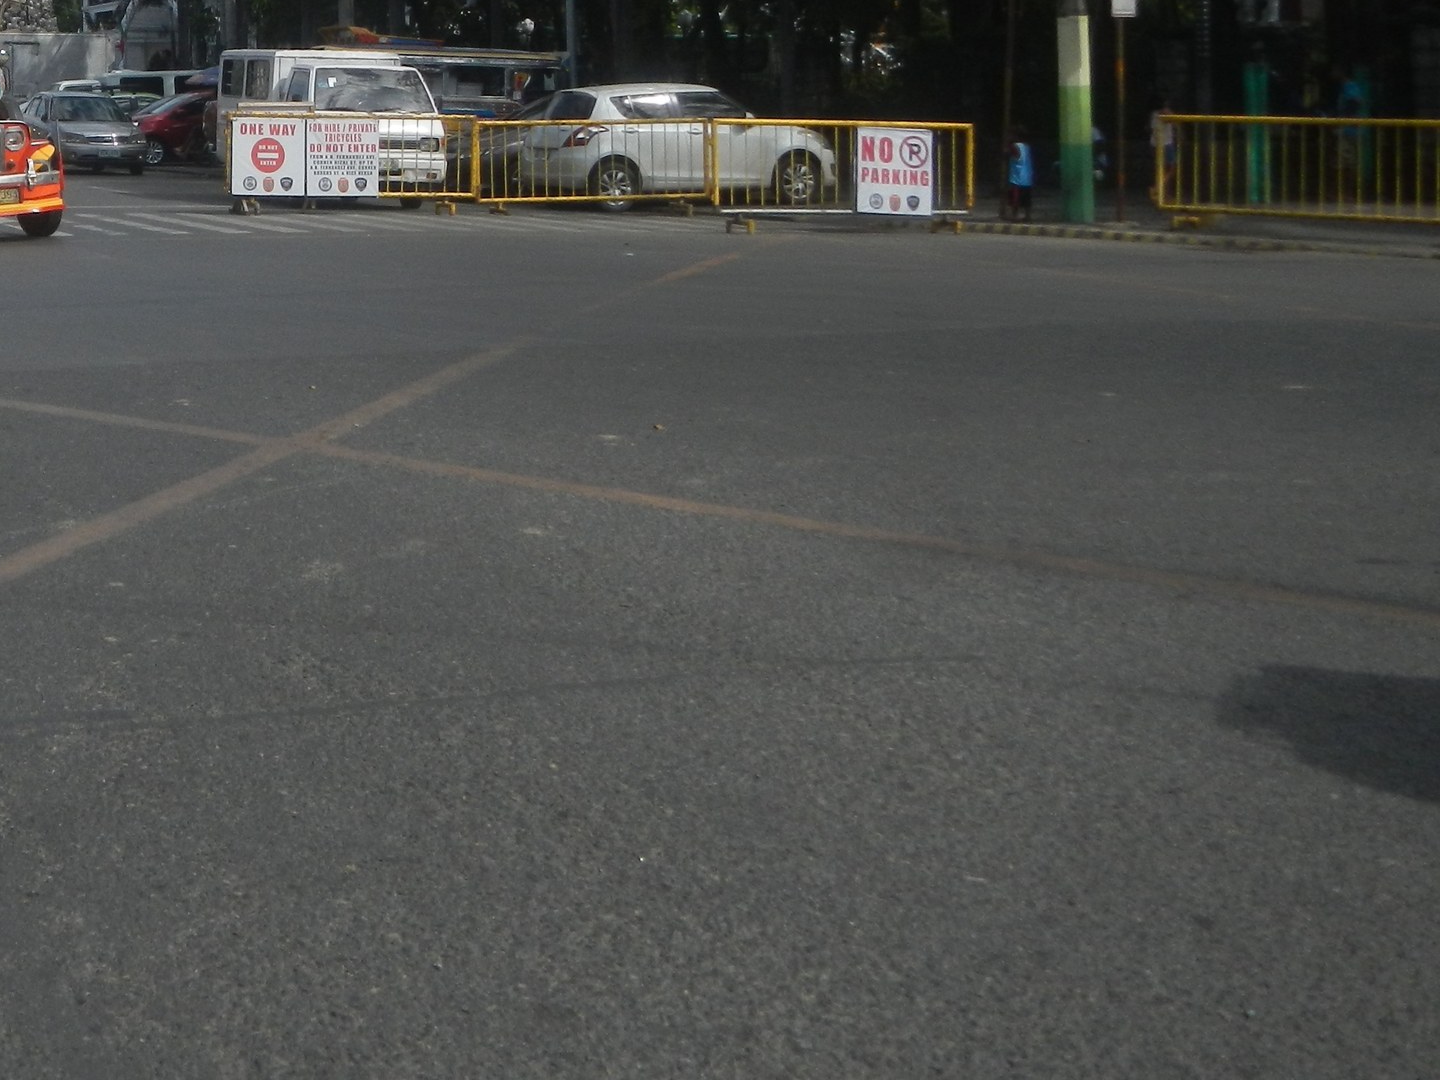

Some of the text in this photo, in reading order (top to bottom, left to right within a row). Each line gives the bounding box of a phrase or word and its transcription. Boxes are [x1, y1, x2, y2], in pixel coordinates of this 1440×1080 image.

[240, 123, 296, 136] ONE WAY
[309, 123, 322, 132] FOR
[324, 123, 340, 132] HIRE
[348, 123, 377, 133] PRIVATE
[324, 133, 362, 142] TRICYCLES
[310, 144, 377, 153] DO NOT ENTER
[861, 136, 894, 164] NO
[861, 167, 929, 187] PARKING
